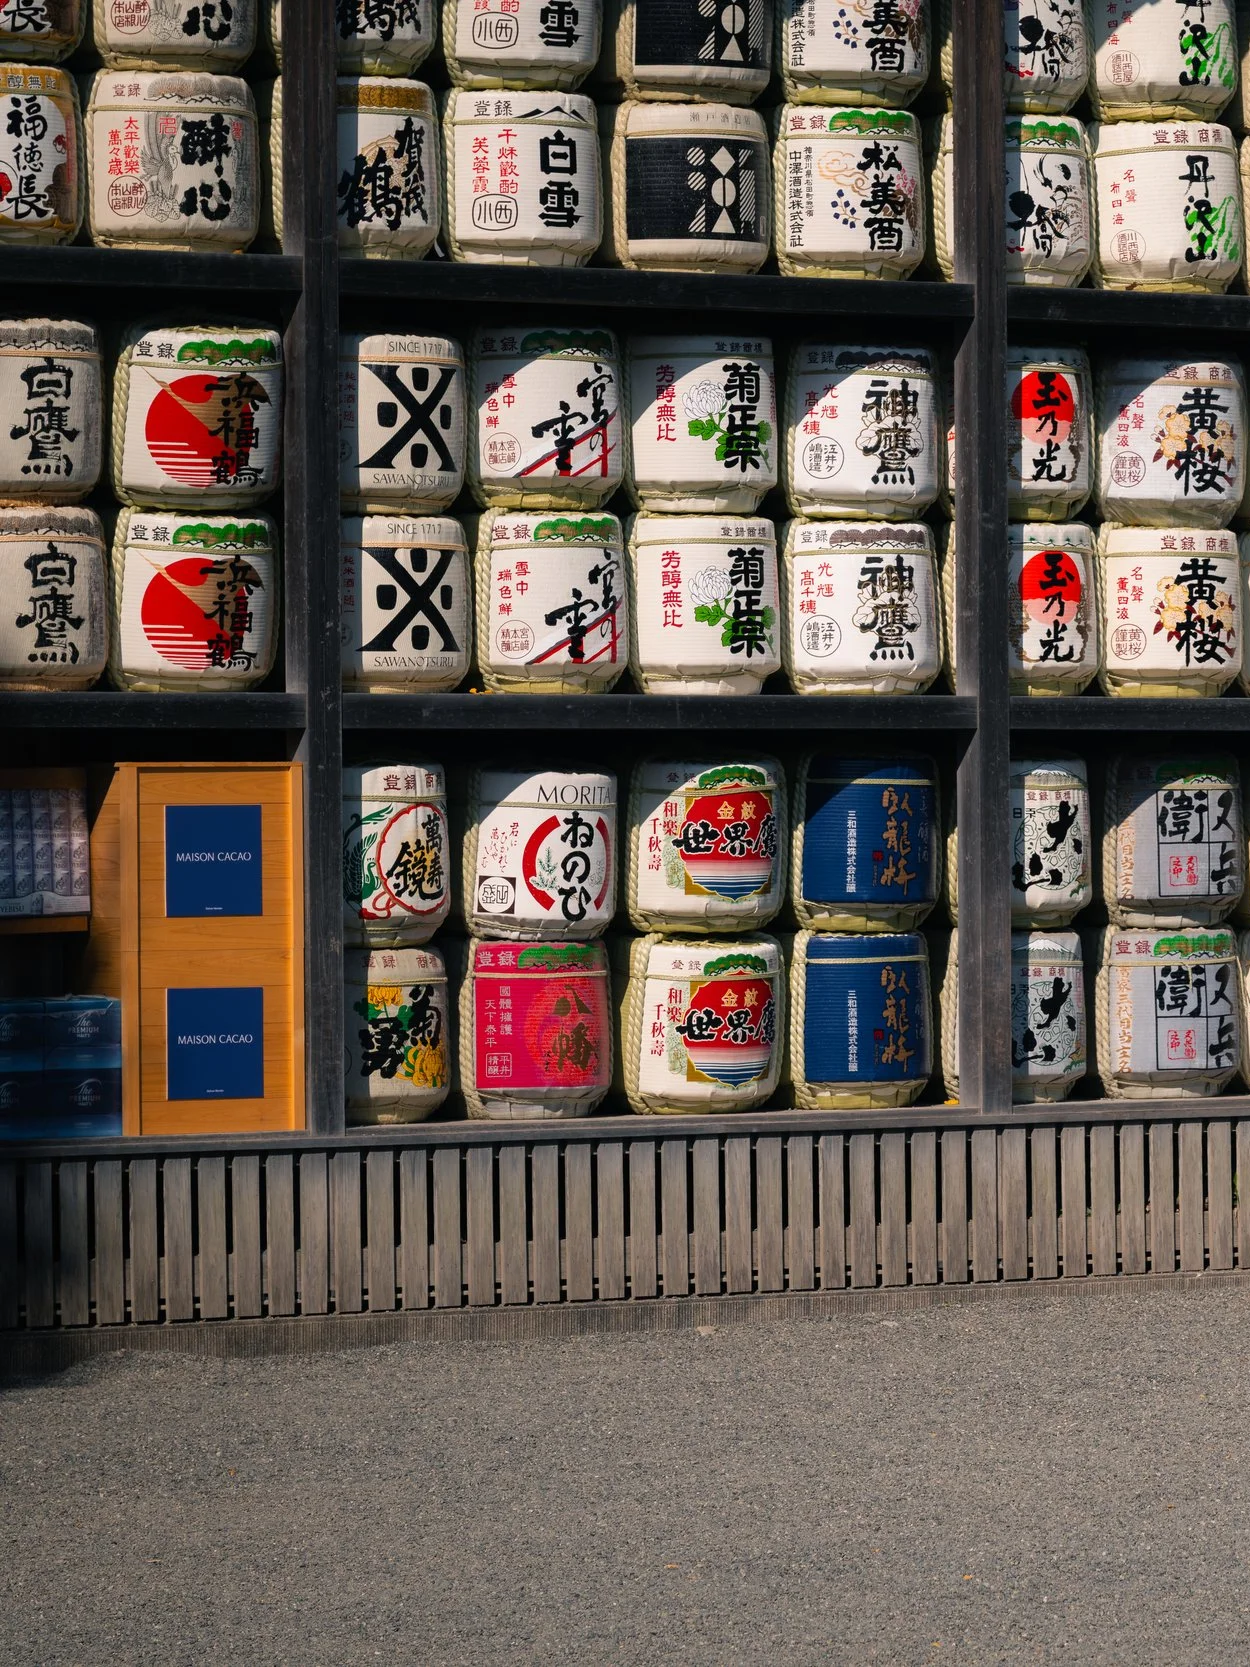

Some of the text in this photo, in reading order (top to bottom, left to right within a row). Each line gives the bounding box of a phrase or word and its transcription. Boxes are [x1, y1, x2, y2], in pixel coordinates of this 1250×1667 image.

[112, 84, 141, 98] 登録
[790, 115, 826, 131] 登録
[538, 129, 584, 229] 白雪
[789, 150, 803, 247] 中澤酒造株式会社
[136, 341, 175, 359] 登録
[388, 341, 420, 353] SINCE
[485, 382, 500, 428] 瑞色鮮
[502, 374, 517, 408] 雪中
[656, 364, 677, 442] 芳醇無比
[821, 384, 838, 419] 光輝
[722, 362, 761, 473] 菊正宗
[1032, 371, 1068, 482] 玉乃光
[373, 473, 449, 490] SAWANOTSURU
[131, 525, 170, 542] 登録
[388, 523, 441, 534] SINCE 1717
[492, 524, 530, 540] 登録
[801, 530, 828, 544] 登録
[498, 570, 512, 616] 瑞色鮮
[515, 561, 530, 596] 雪中
[661, 550, 683, 629] 芳醇無比
[817, 562, 834, 597] 光輝
[728, 547, 766, 659] 菊正宗
[1039, 554, 1075, 663] 玉乃光
[374, 656, 454, 668] SAWANOTSURU
[537, 784, 611, 804] MORITA
[663, 801, 678, 835] 和楽
[176, 851, 251, 862] MAISON CACAO
[558, 811, 594, 921] ねのひ
[478, 951, 516, 967] 登録
[1116, 940, 1151, 955] 登録
[672, 960, 701, 971] 登録
[667, 987, 683, 1023] 和楽
[178, 1034, 253, 1045] MAISON CACAO
[484, 1000, 497, 1048] 天下泰平
